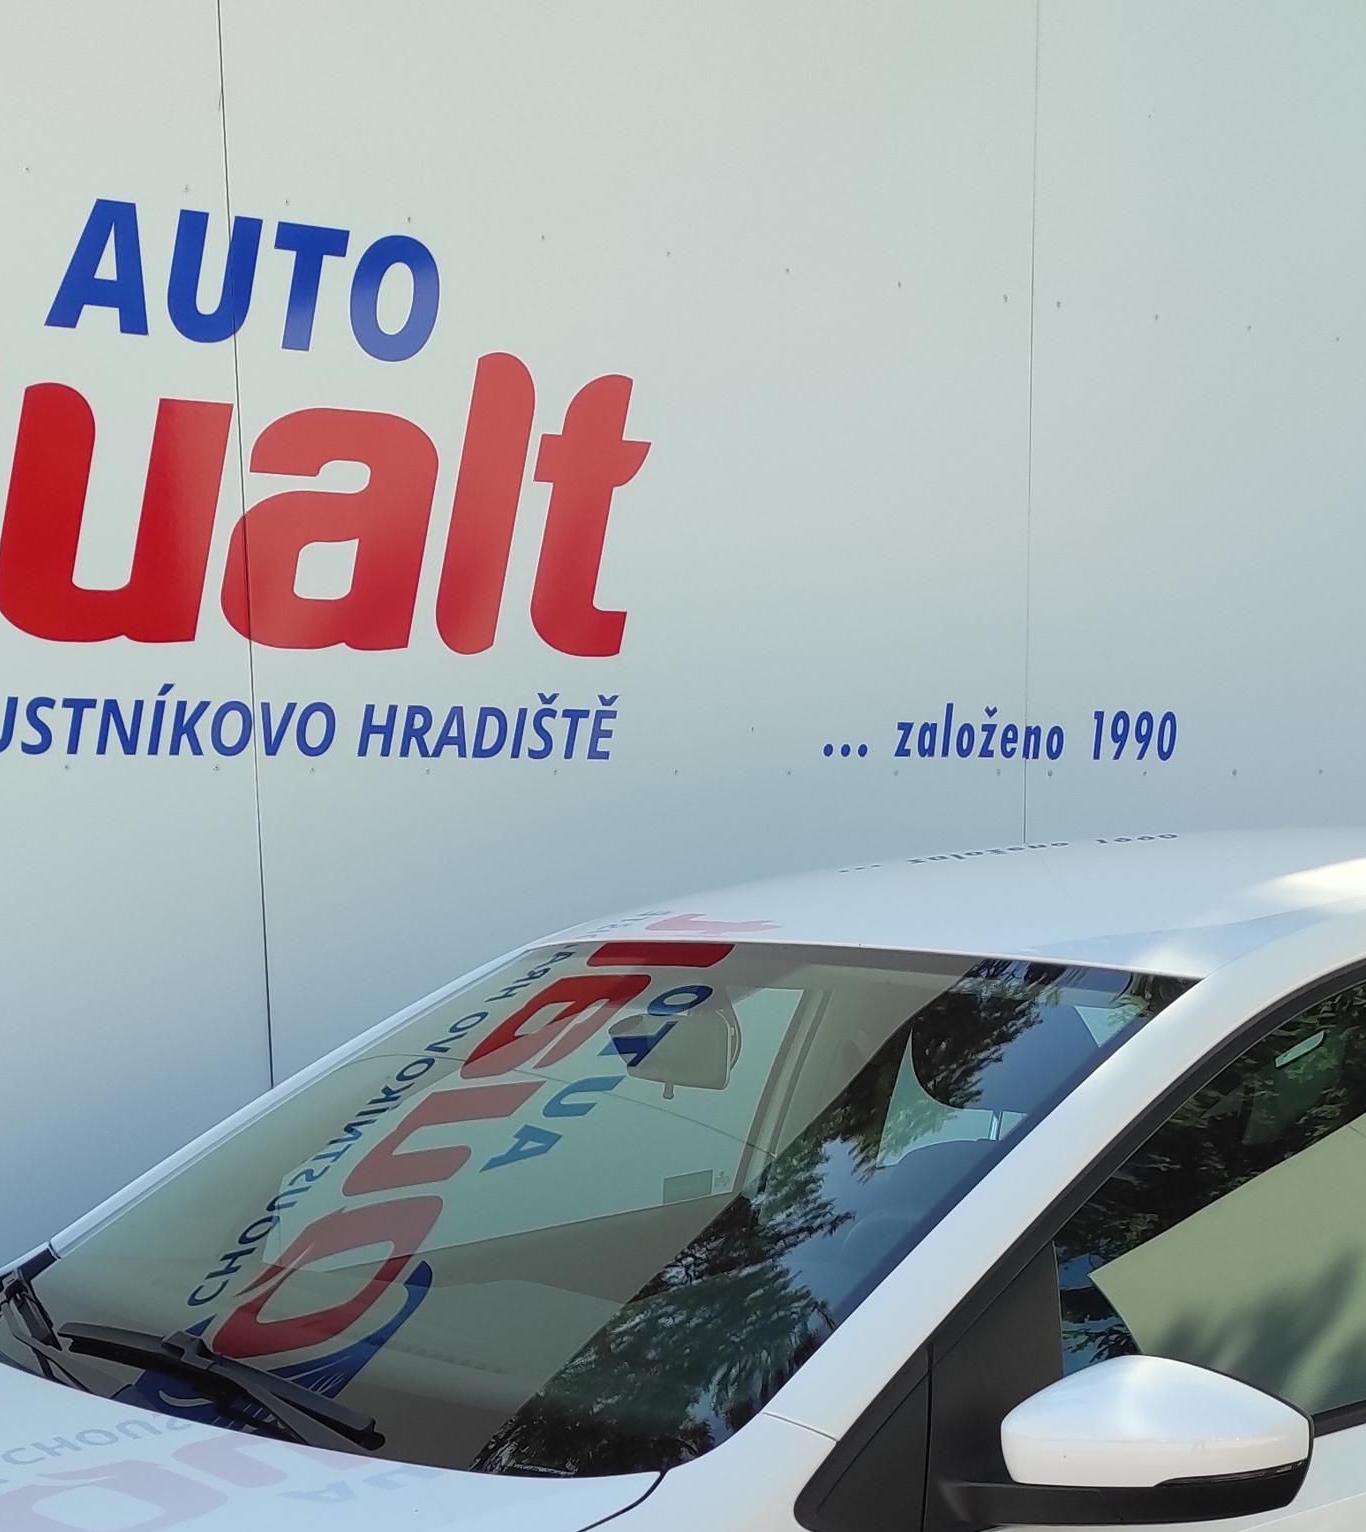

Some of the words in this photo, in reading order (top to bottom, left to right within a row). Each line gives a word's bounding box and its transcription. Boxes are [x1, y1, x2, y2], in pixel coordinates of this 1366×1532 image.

[46, 198, 439, 361] AUTO
[358, 692, 618, 761] HRADIŠTĚ
[894, 702, 1066, 761] založeno
[1092, 709, 1179, 763] 1990
